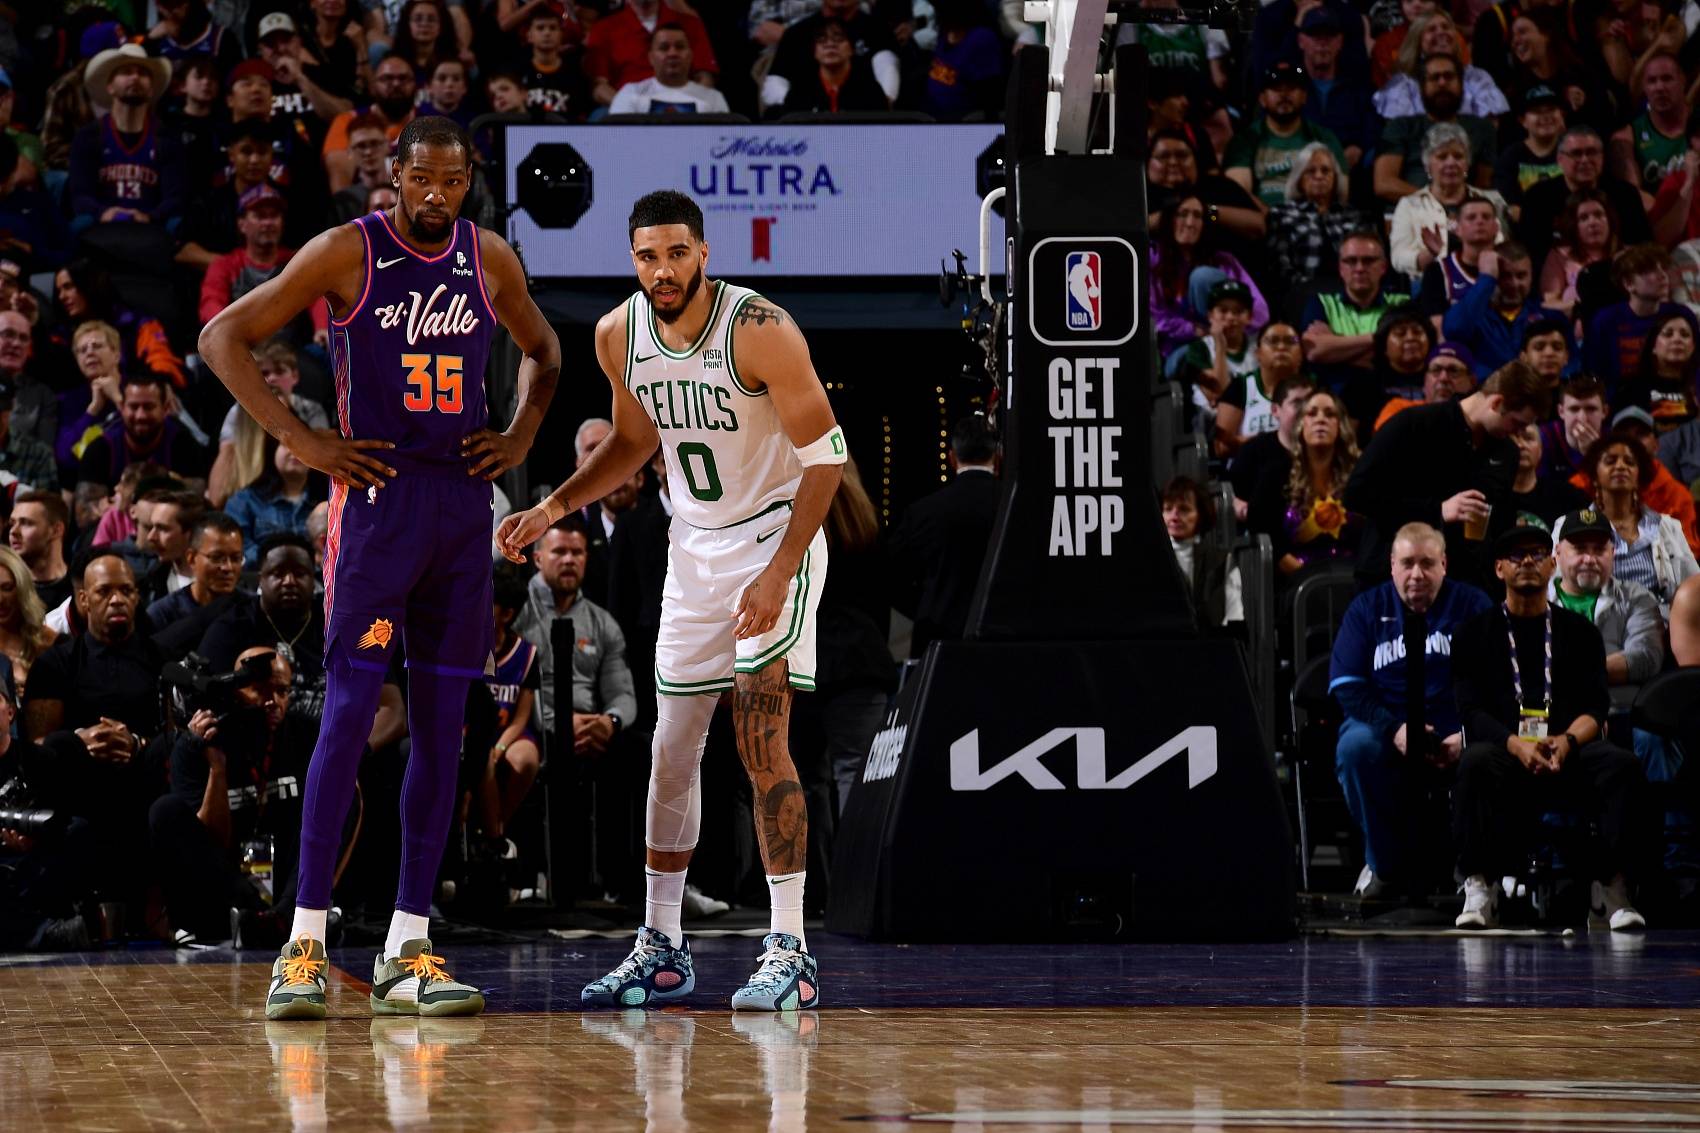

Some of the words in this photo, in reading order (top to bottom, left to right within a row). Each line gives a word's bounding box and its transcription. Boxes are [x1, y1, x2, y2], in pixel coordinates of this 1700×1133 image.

[690, 164, 838, 195] ULTRA
[452, 267, 473, 277] PayPal
[406, 283, 480, 346] Valle
[1071, 312, 1089, 326] NBA
[401, 354, 464, 414] 35
[702, 349, 723, 361] VISTA
[703, 361, 723, 369] PRINT
[635, 380, 739, 432] CELTICS
[1048, 357, 1120, 420] GET
[676, 441, 724, 502] 0
[1048, 426, 1123, 487] THE
[1049, 495, 1124, 556] APP
[950, 725, 1218, 791] KIA
